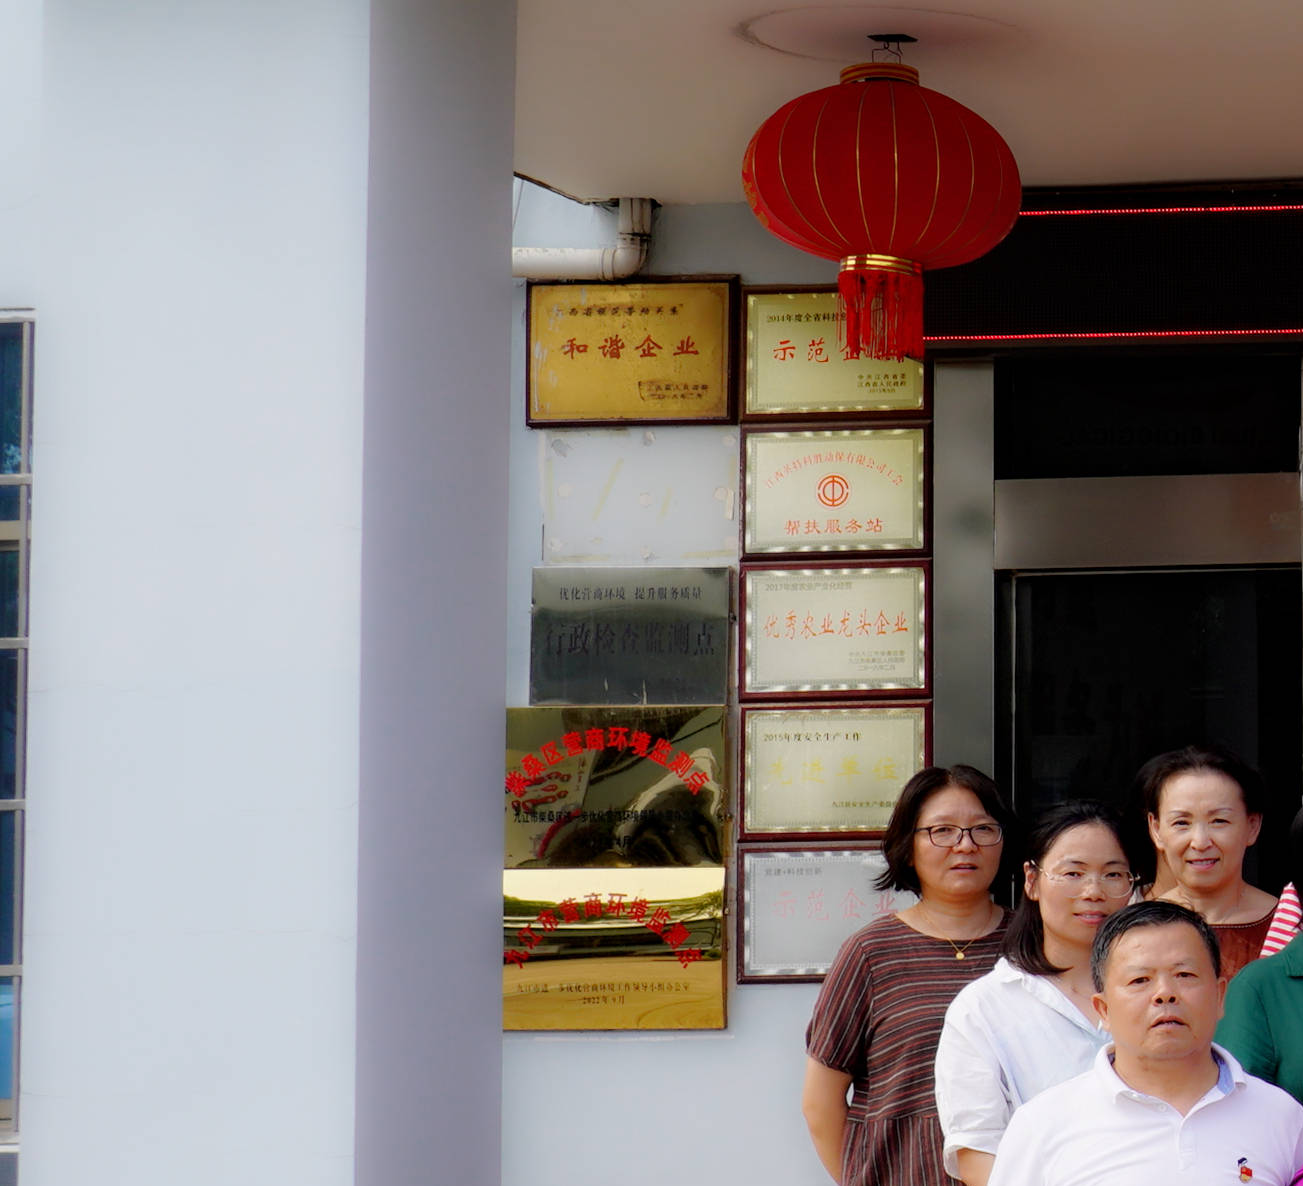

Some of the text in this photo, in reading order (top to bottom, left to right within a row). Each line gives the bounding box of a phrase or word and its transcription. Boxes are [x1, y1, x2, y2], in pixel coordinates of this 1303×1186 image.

[561, 335, 699, 360] 和谐企业
[784, 518, 883, 536] 帮扶服务站
[505, 727, 710, 797] 柴桑区营商环境监测点
[768, 754, 899, 784] 先进单位
[772, 887, 899, 921] 示范企业
